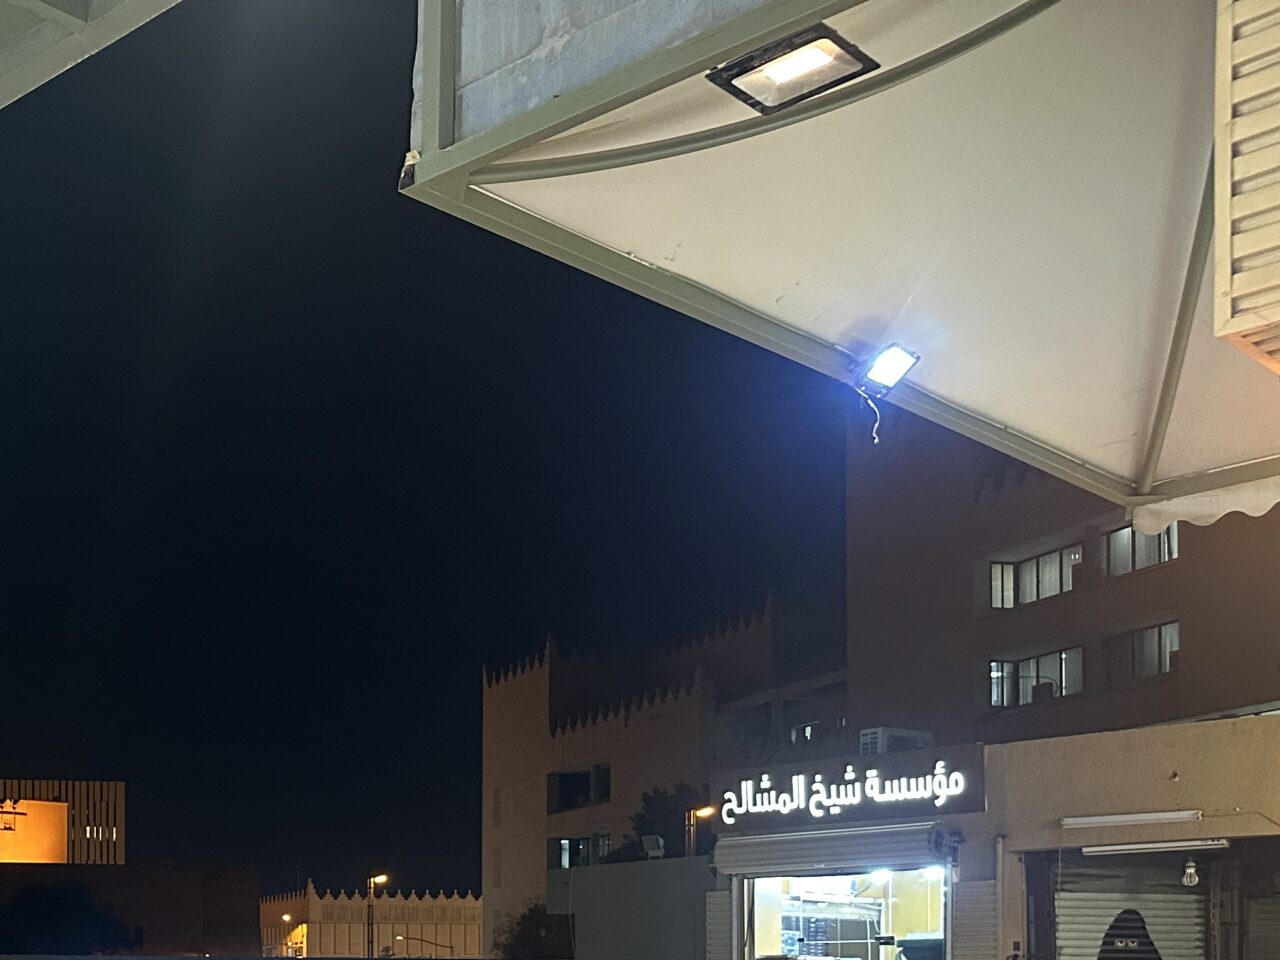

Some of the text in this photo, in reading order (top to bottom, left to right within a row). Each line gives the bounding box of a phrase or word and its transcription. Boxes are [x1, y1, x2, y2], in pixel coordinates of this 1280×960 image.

[721, 760, 965, 825] مؤسسة شيخ المشالح
